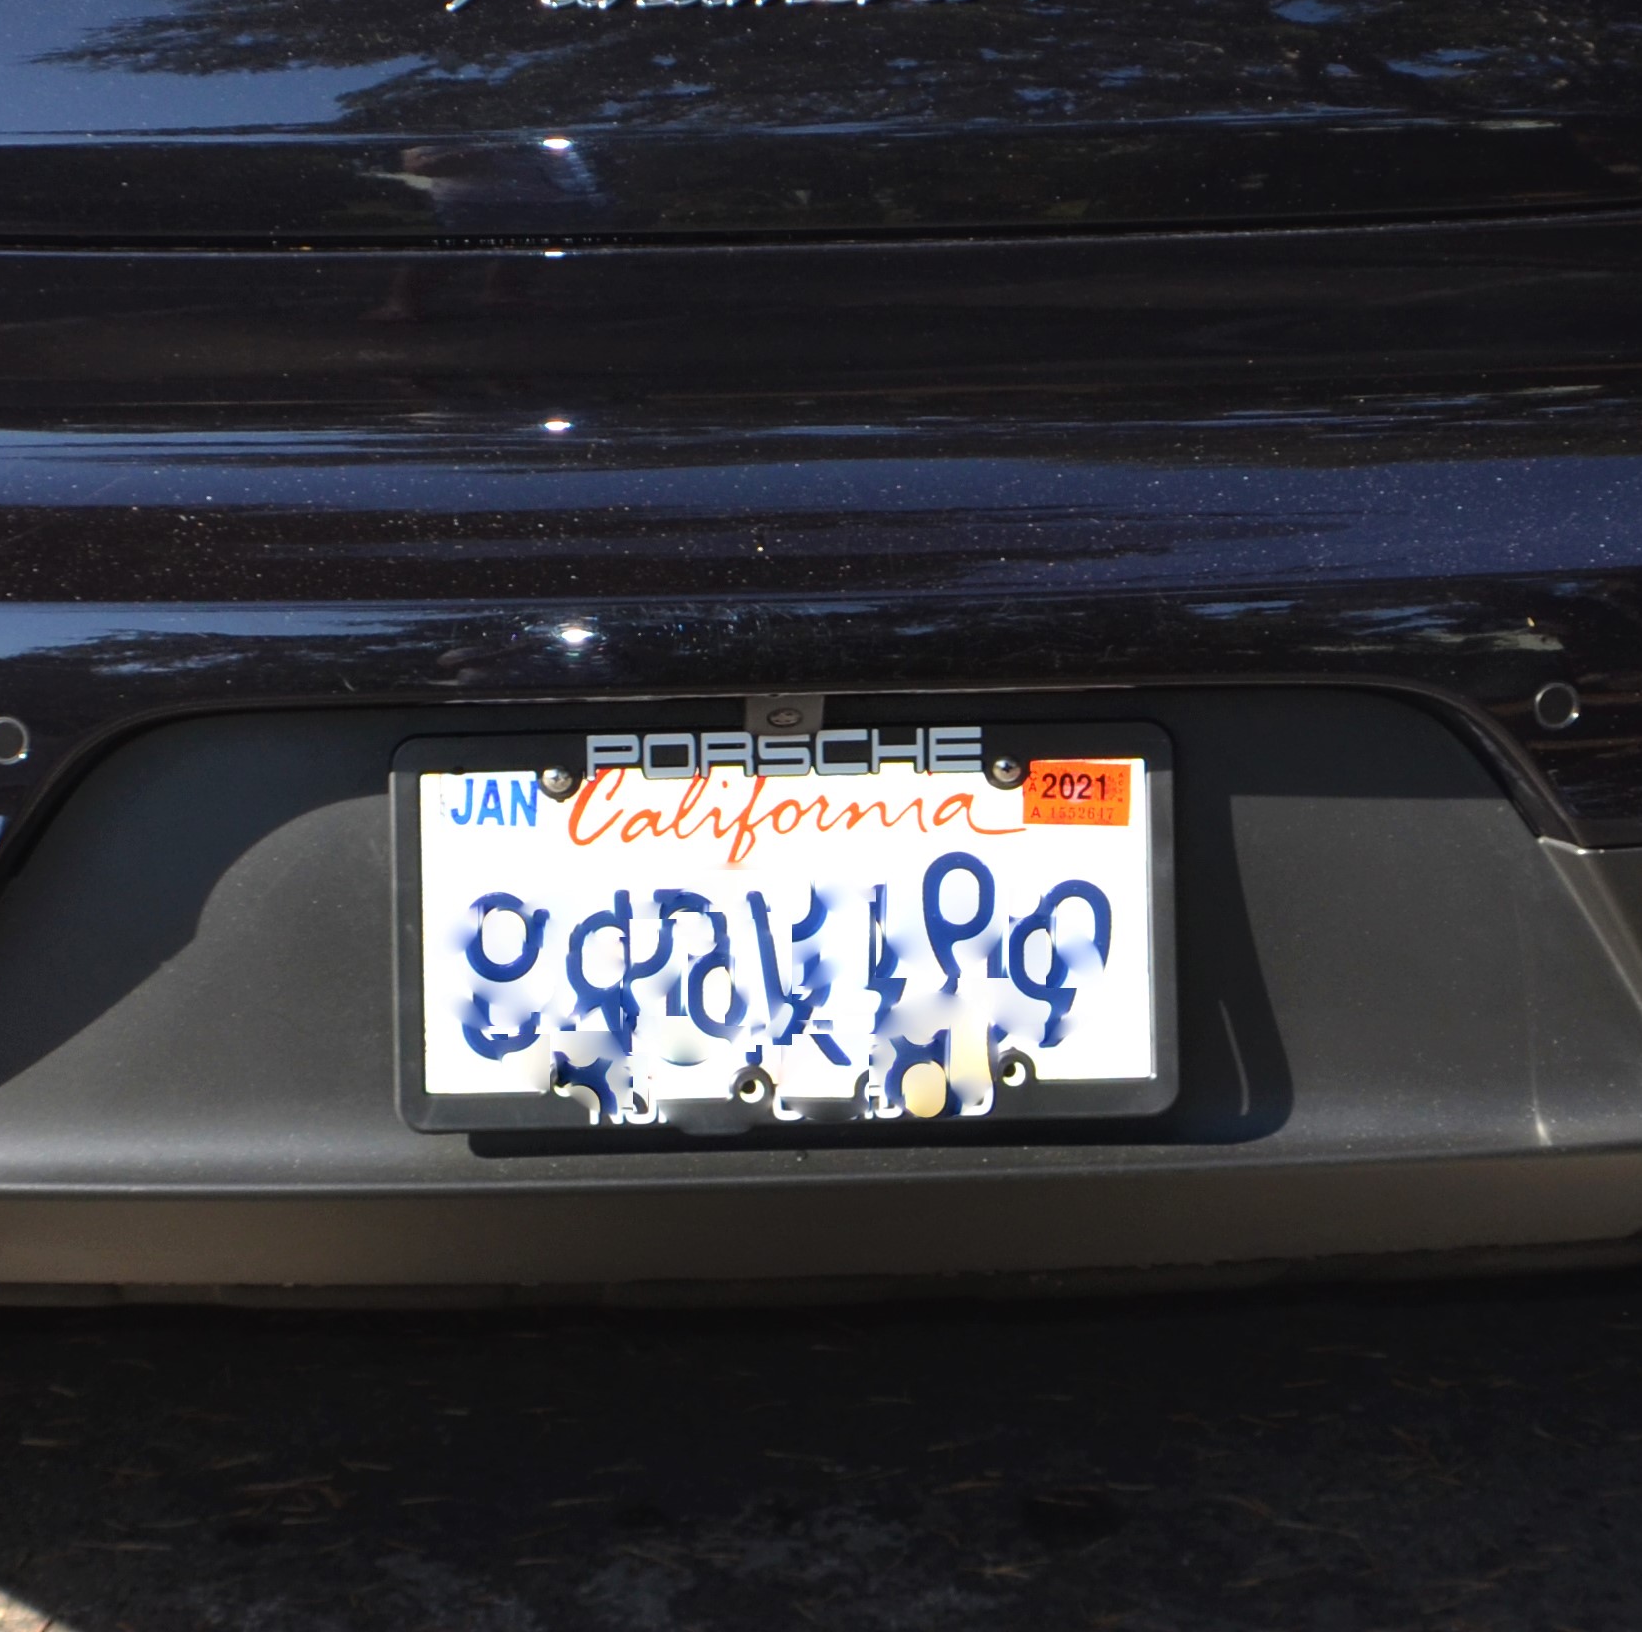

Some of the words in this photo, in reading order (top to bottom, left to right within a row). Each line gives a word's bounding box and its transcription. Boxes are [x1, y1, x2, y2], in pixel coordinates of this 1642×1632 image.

[585, 726, 984, 782] PORSCHE
[450, 778, 539, 827] JAN
[1041, 772, 1106, 800] 2021
[567, 768, 1027, 864] California
